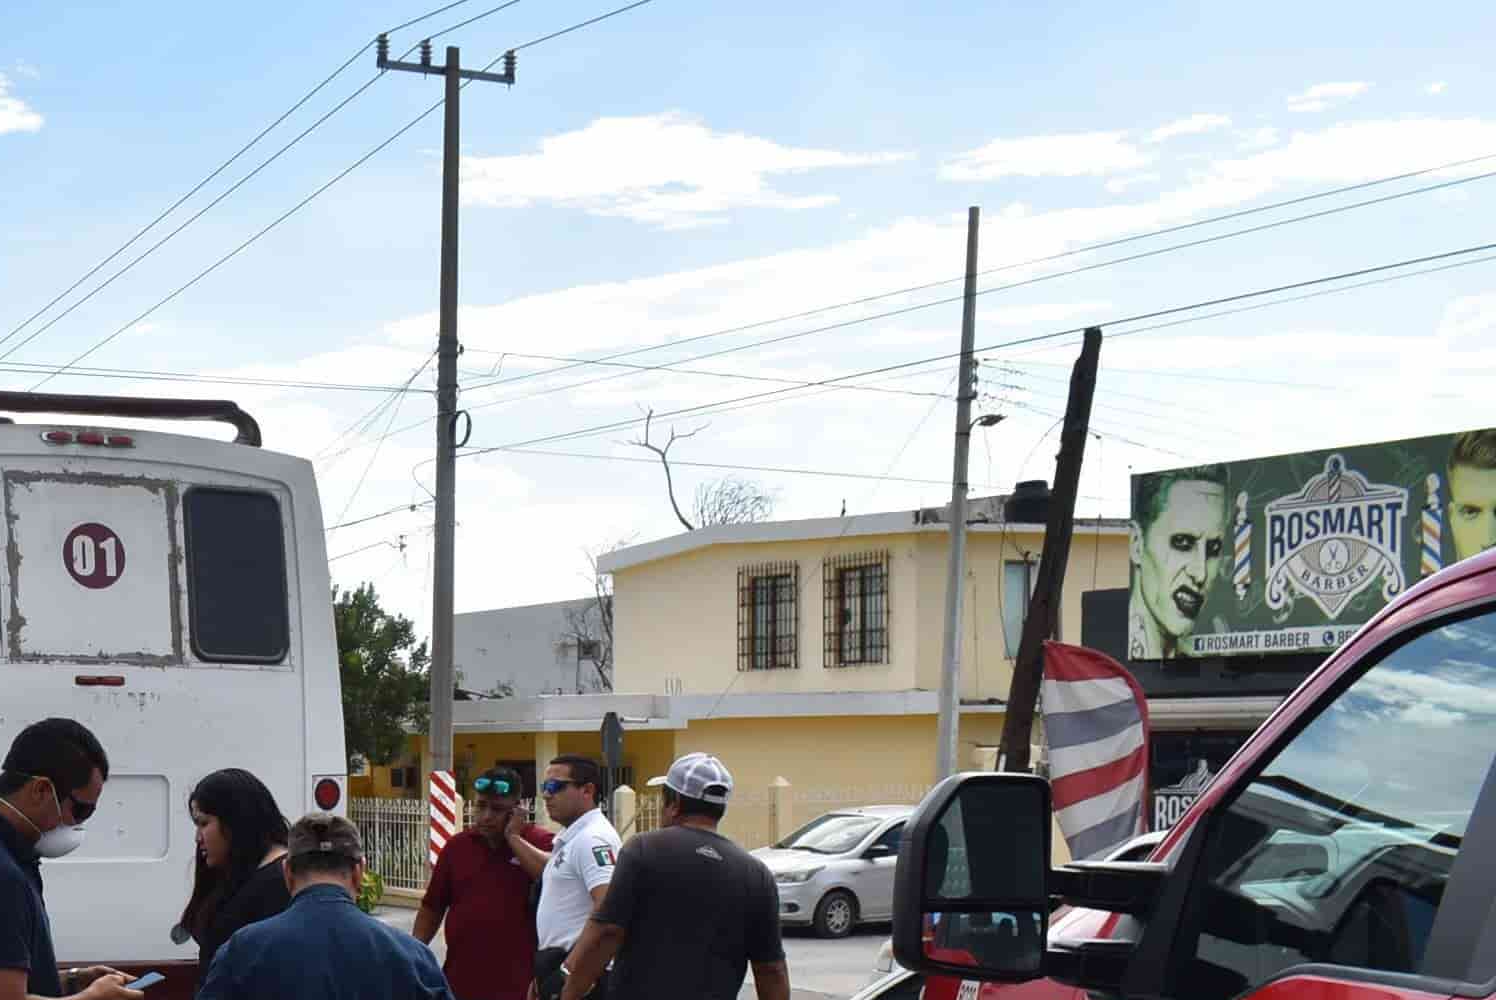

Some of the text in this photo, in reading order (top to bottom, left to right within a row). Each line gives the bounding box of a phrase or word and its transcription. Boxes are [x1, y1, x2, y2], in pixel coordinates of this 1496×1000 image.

[1270, 502, 1402, 568] ROSMART
[72, 535, 117, 577] 01
[1301, 563, 1369, 590] BARBER
[1207, 631, 1310, 650] ROSMART BARBER
